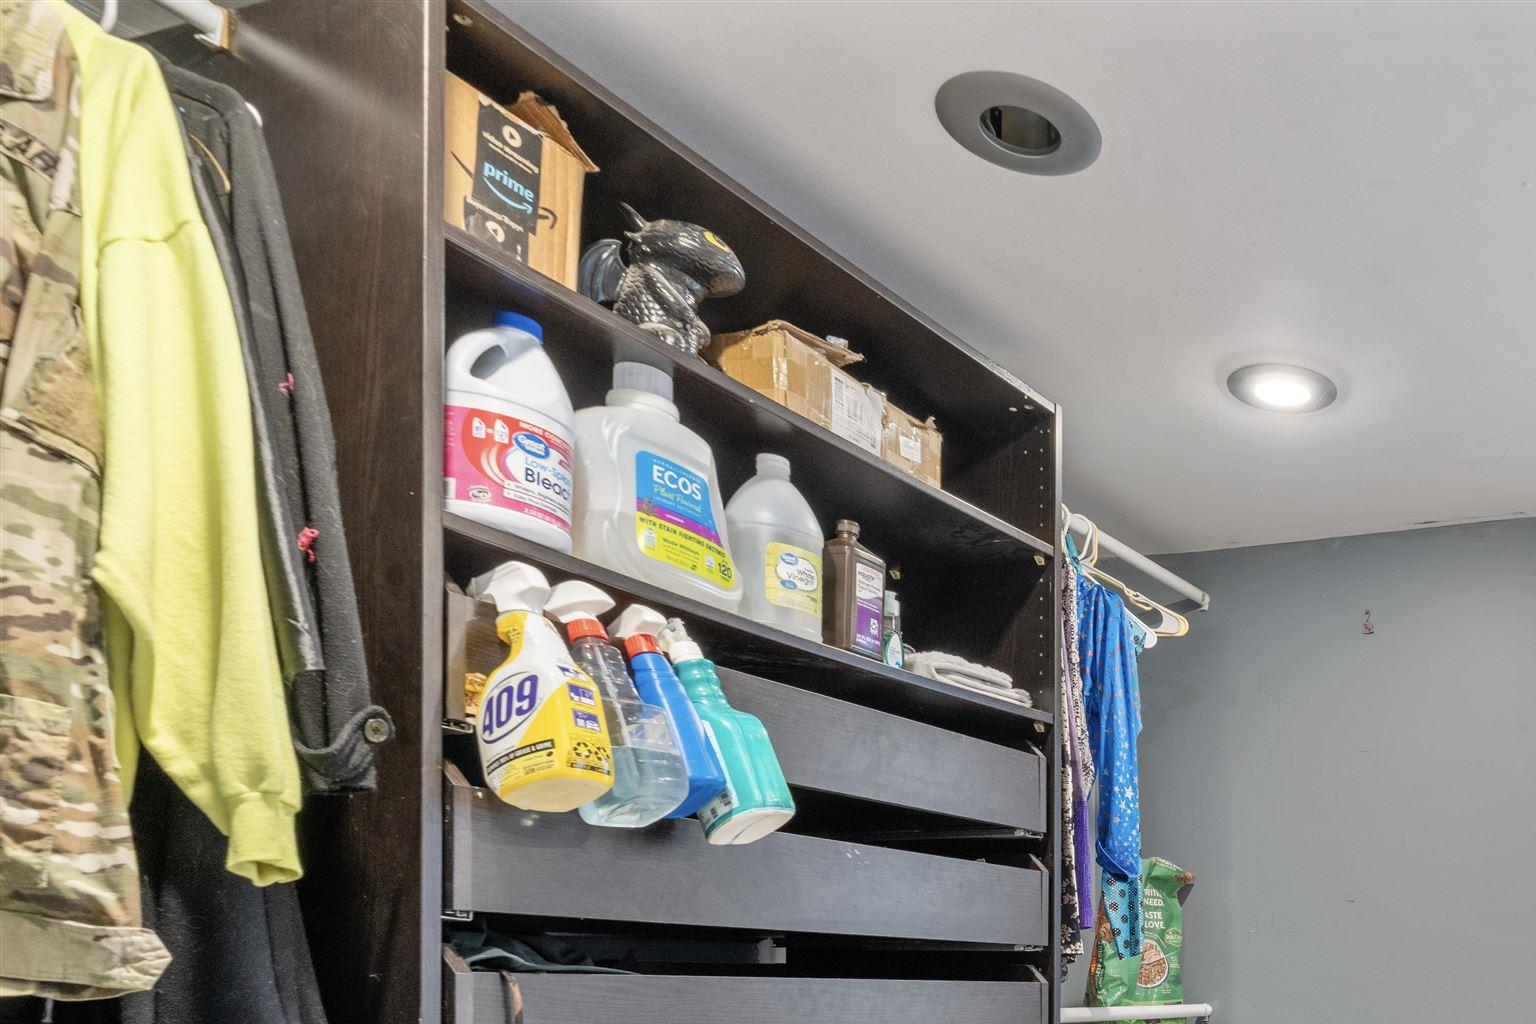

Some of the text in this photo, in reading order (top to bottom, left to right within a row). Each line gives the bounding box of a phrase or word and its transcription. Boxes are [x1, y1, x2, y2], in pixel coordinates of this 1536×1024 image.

[483, 161, 535, 203] prime
[652, 464, 702, 501] ECOS
[718, 562, 732, 579] 120
[482, 674, 539, 737] 409
